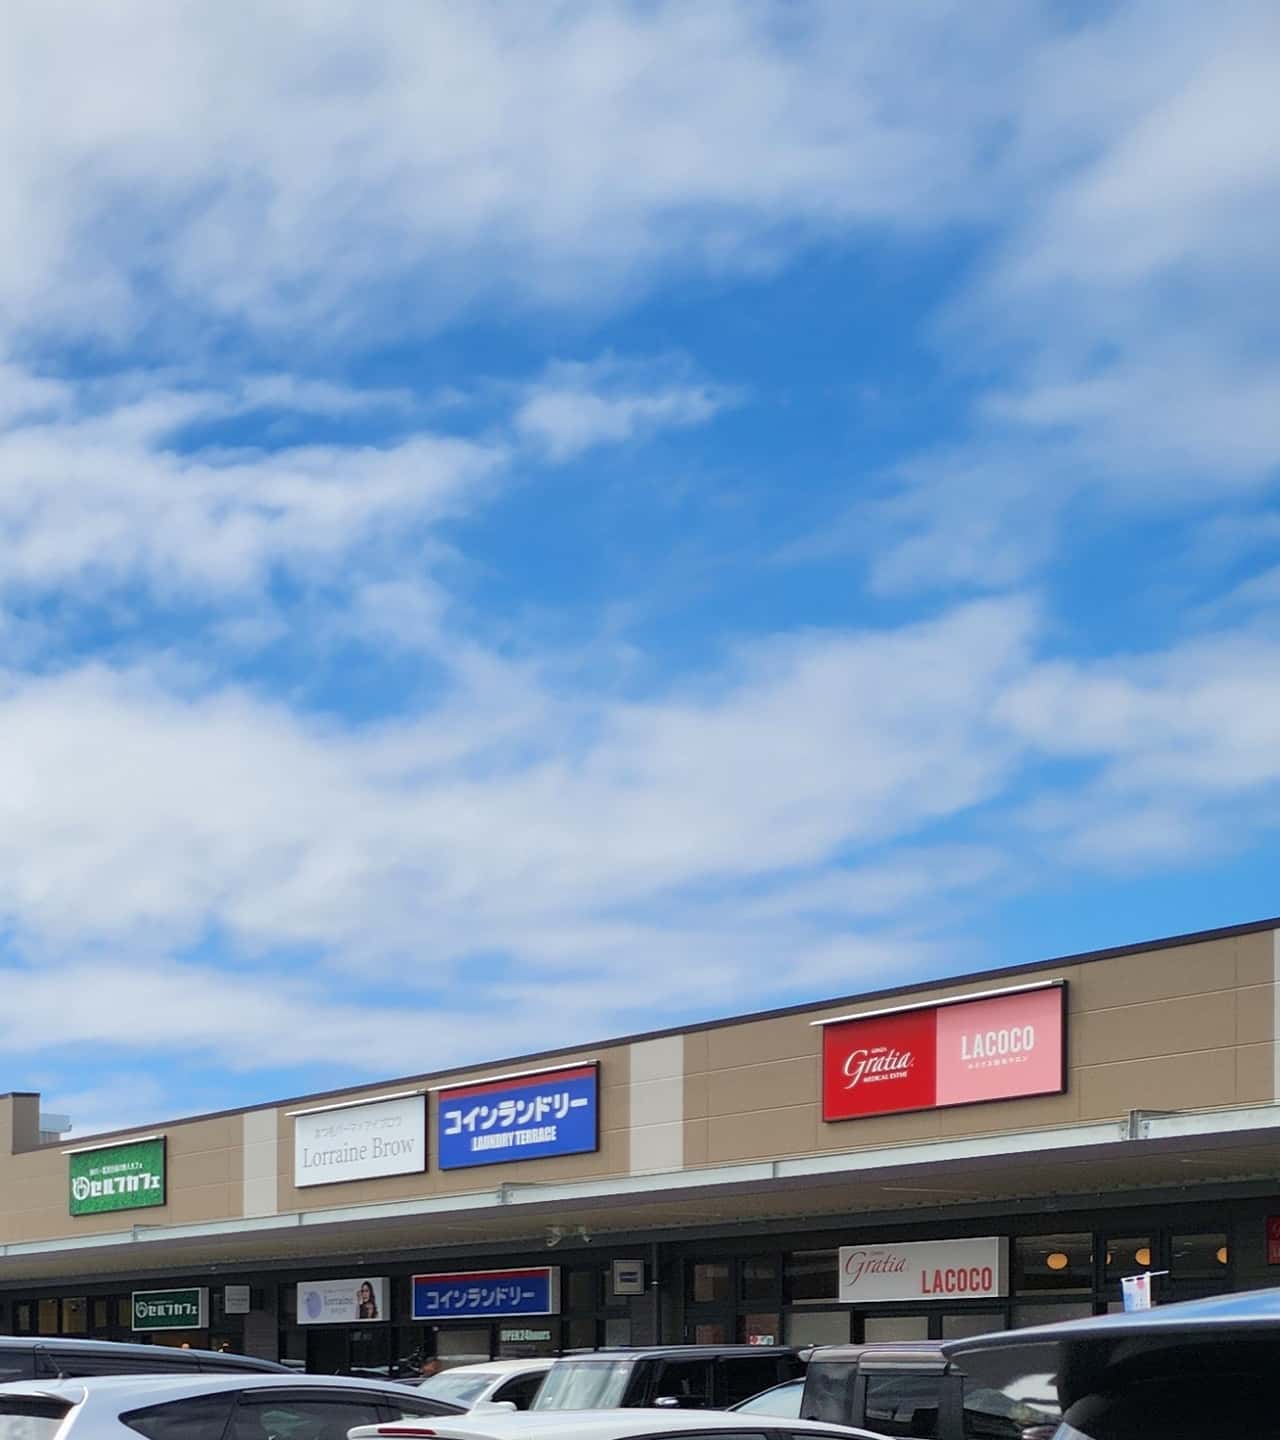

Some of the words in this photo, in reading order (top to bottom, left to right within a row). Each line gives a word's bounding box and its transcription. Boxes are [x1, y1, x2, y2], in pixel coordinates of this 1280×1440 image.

[961, 1025, 1035, 1060] LACOCO
[844, 1048, 912, 1089] Gratia
[444, 1092, 589, 1136] コインランドリー
[303, 1142, 368, 1169] Lorraine
[372, 1137, 416, 1160] Brow
[845, 1252, 907, 1287] Gratia
[922, 1267, 993, 1294] LACOCO
[426, 1286, 536, 1310] コインランドリー
